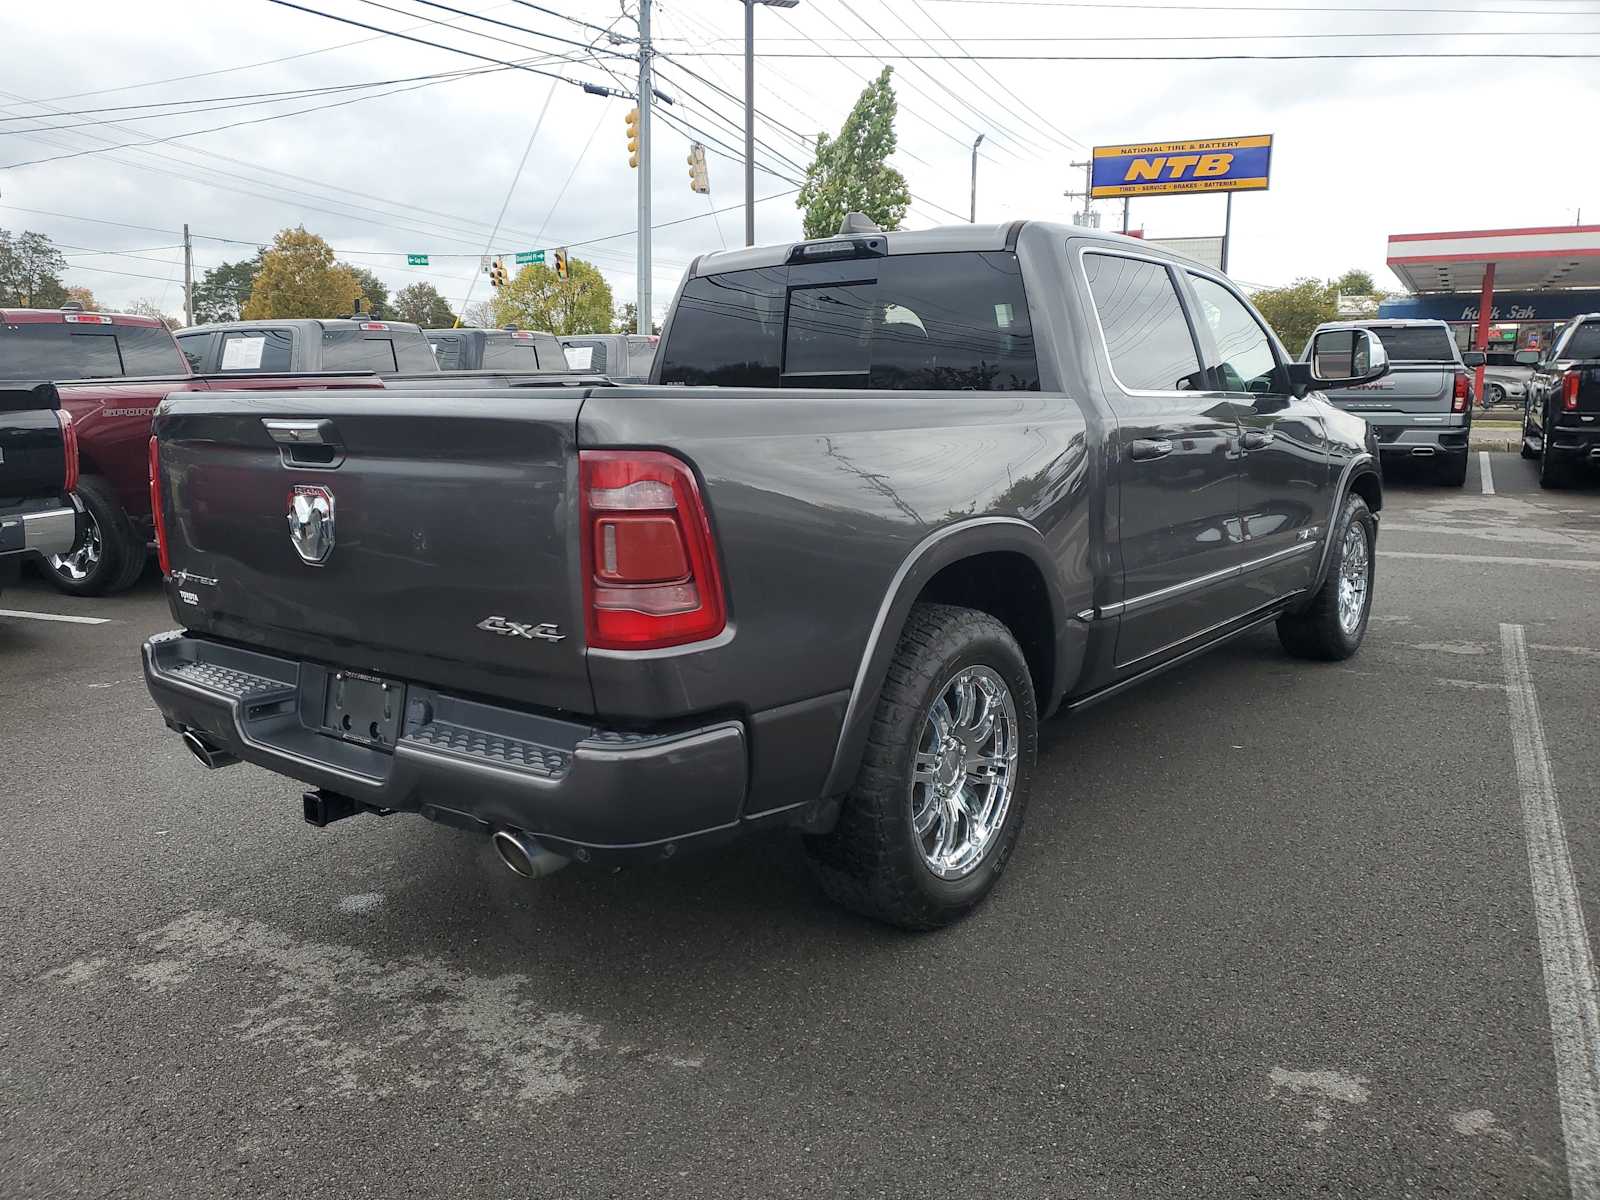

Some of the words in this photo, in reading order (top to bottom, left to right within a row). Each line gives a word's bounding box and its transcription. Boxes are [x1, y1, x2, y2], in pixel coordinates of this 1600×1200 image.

[1120, 146, 1164, 155] NATIONAL
[1167, 144, 1185, 152] TIRE
[1199, 140, 1240, 149] BATTERY
[1123, 153, 1235, 181] NTB
[1204, 180, 1238, 188] BATTERIES
[1506, 305, 1536, 319] Sak
